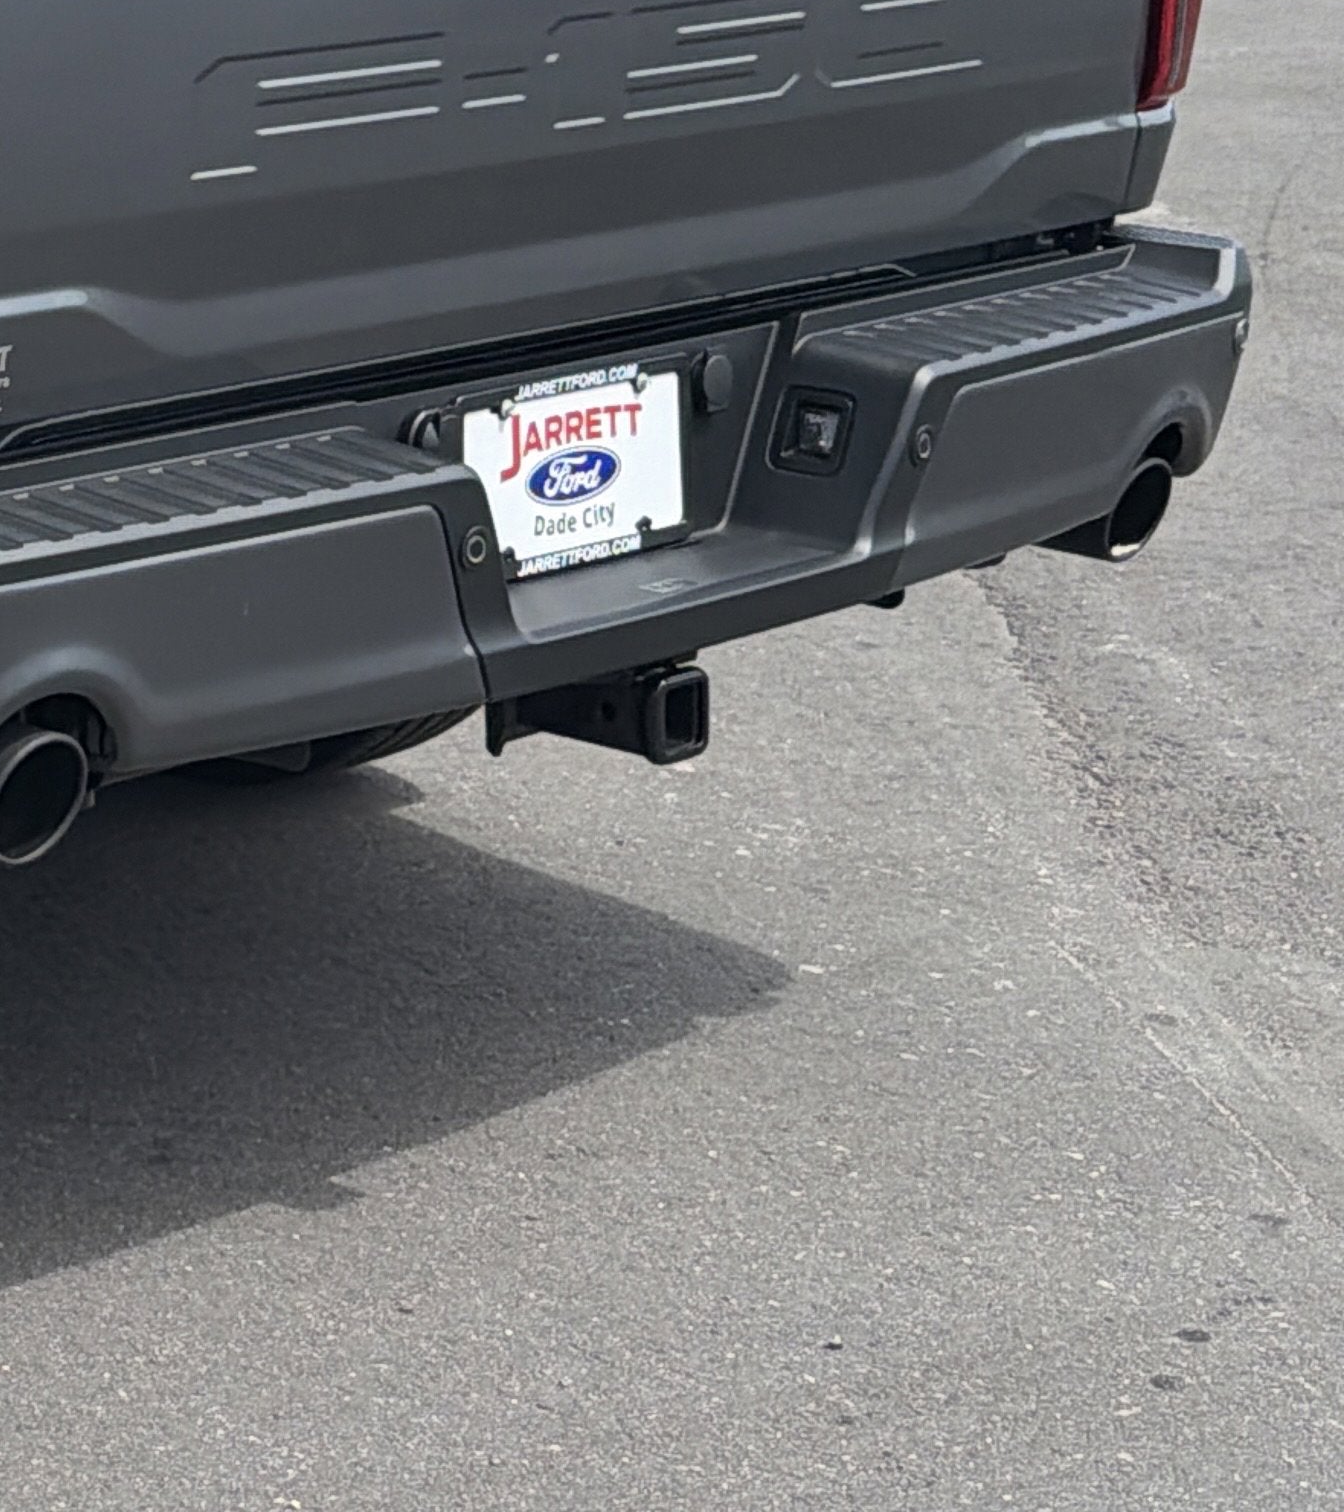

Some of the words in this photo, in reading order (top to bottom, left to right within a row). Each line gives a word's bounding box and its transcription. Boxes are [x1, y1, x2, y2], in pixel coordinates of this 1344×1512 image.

[515, 363, 639, 401] JARRETTFORD.COM
[500, 403, 643, 484] JARRETT
[543, 455, 603, 498] Ford
[534, 512, 578, 537] Dade
[582, 501, 616, 527] City
[517, 536, 642, 578] JARRETTFORD.COM
